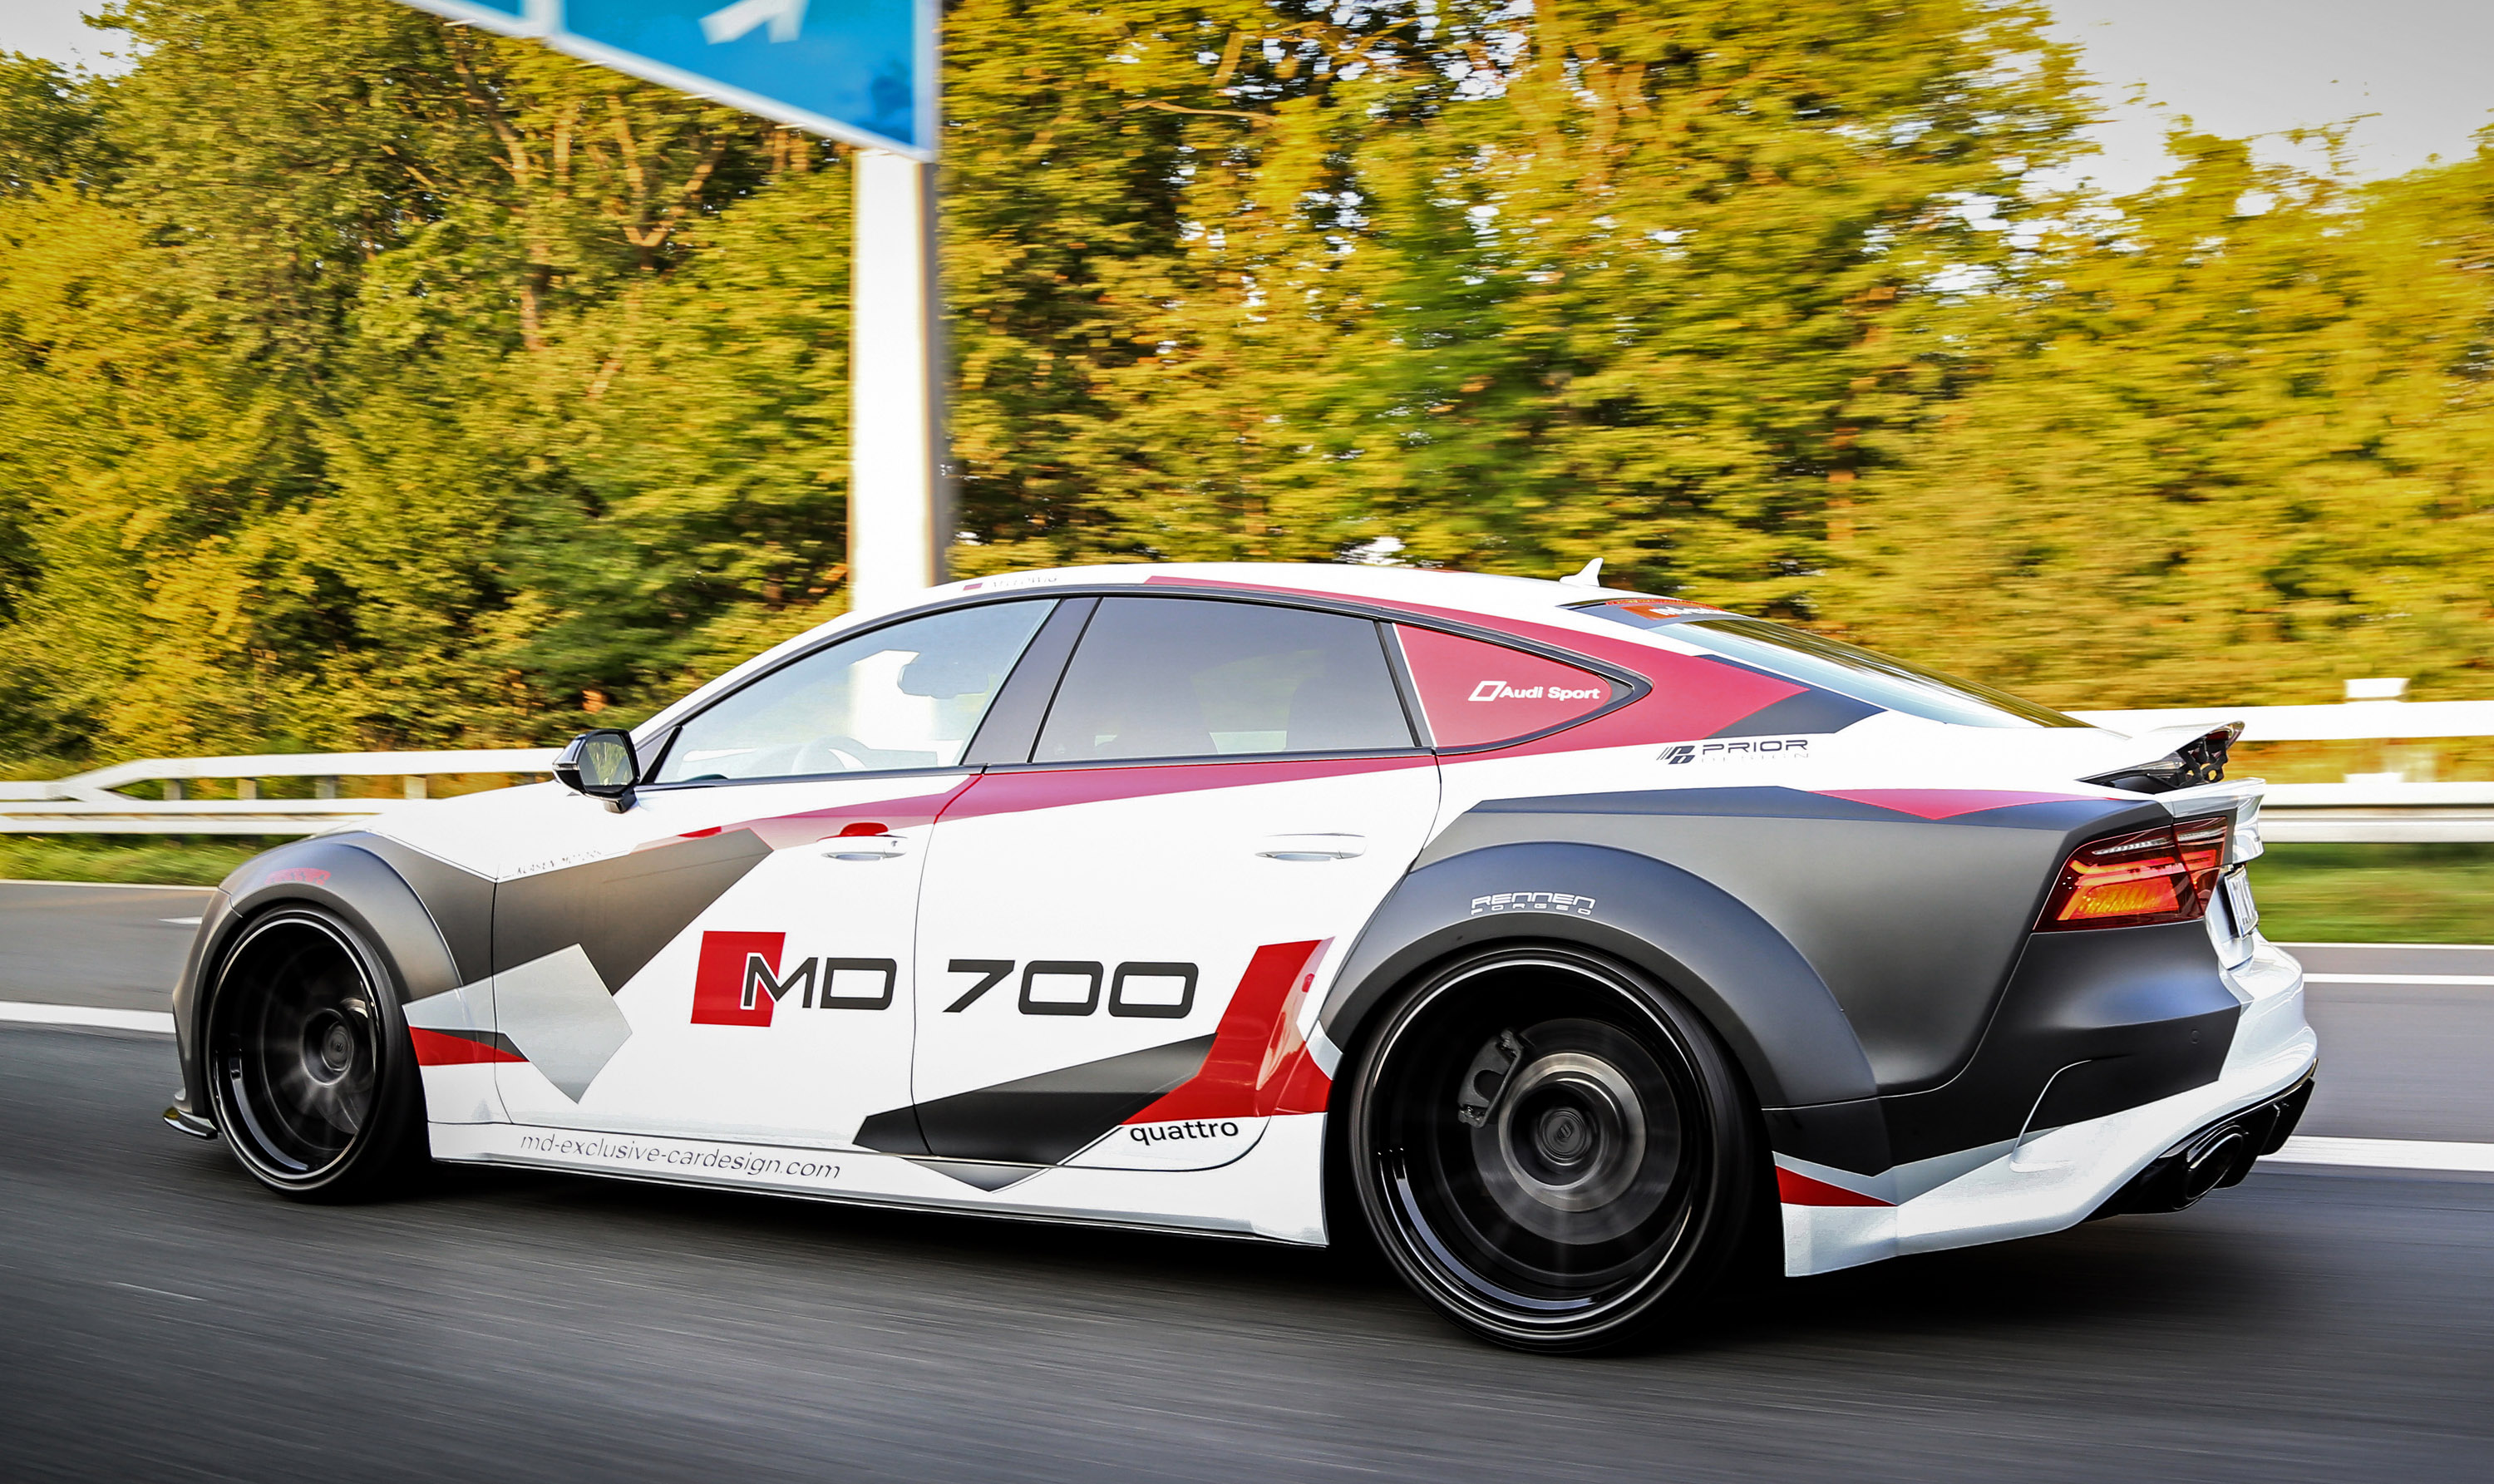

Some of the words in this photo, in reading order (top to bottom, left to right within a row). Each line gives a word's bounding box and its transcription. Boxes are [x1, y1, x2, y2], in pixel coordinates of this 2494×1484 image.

[1499, 686, 1544, 698] Audi
[1547, 687, 1600, 701] Sport
[1703, 739, 1808, 755] PRIOR
[1471, 891, 1596, 910] RENNEN
[1471, 903, 1592, 915] FORGED
[743, 956, 897, 1010] MD
[942, 959, 1199, 1018] 700
[1130, 1121, 1239, 1146] quattro
[520, 1133, 840, 1179] md-exclusive-cardesign.com
